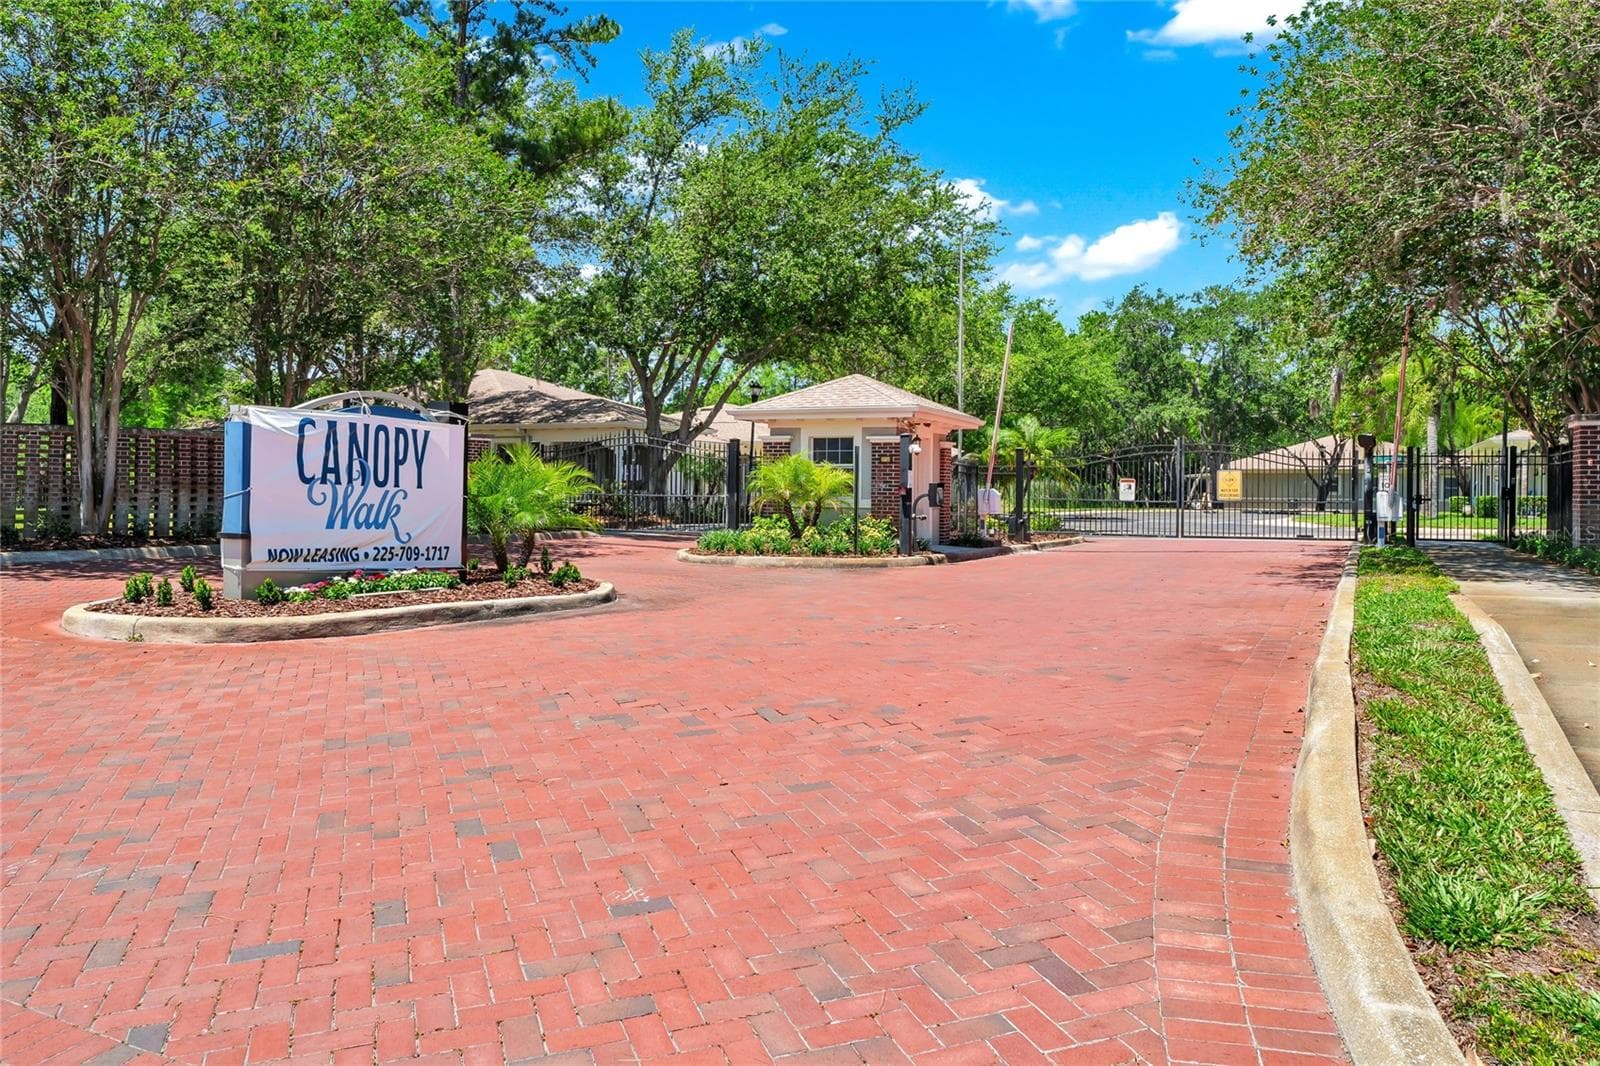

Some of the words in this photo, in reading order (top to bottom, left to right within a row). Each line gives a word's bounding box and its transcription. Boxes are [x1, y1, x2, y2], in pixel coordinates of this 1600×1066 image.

[297, 417, 430, 489] CANOPY
[307, 458, 412, 544] Walk
[266, 548, 303, 563] NOW
[303, 547, 360, 562] LEASING
[372, 546, 450, 561] 225-709-1717
